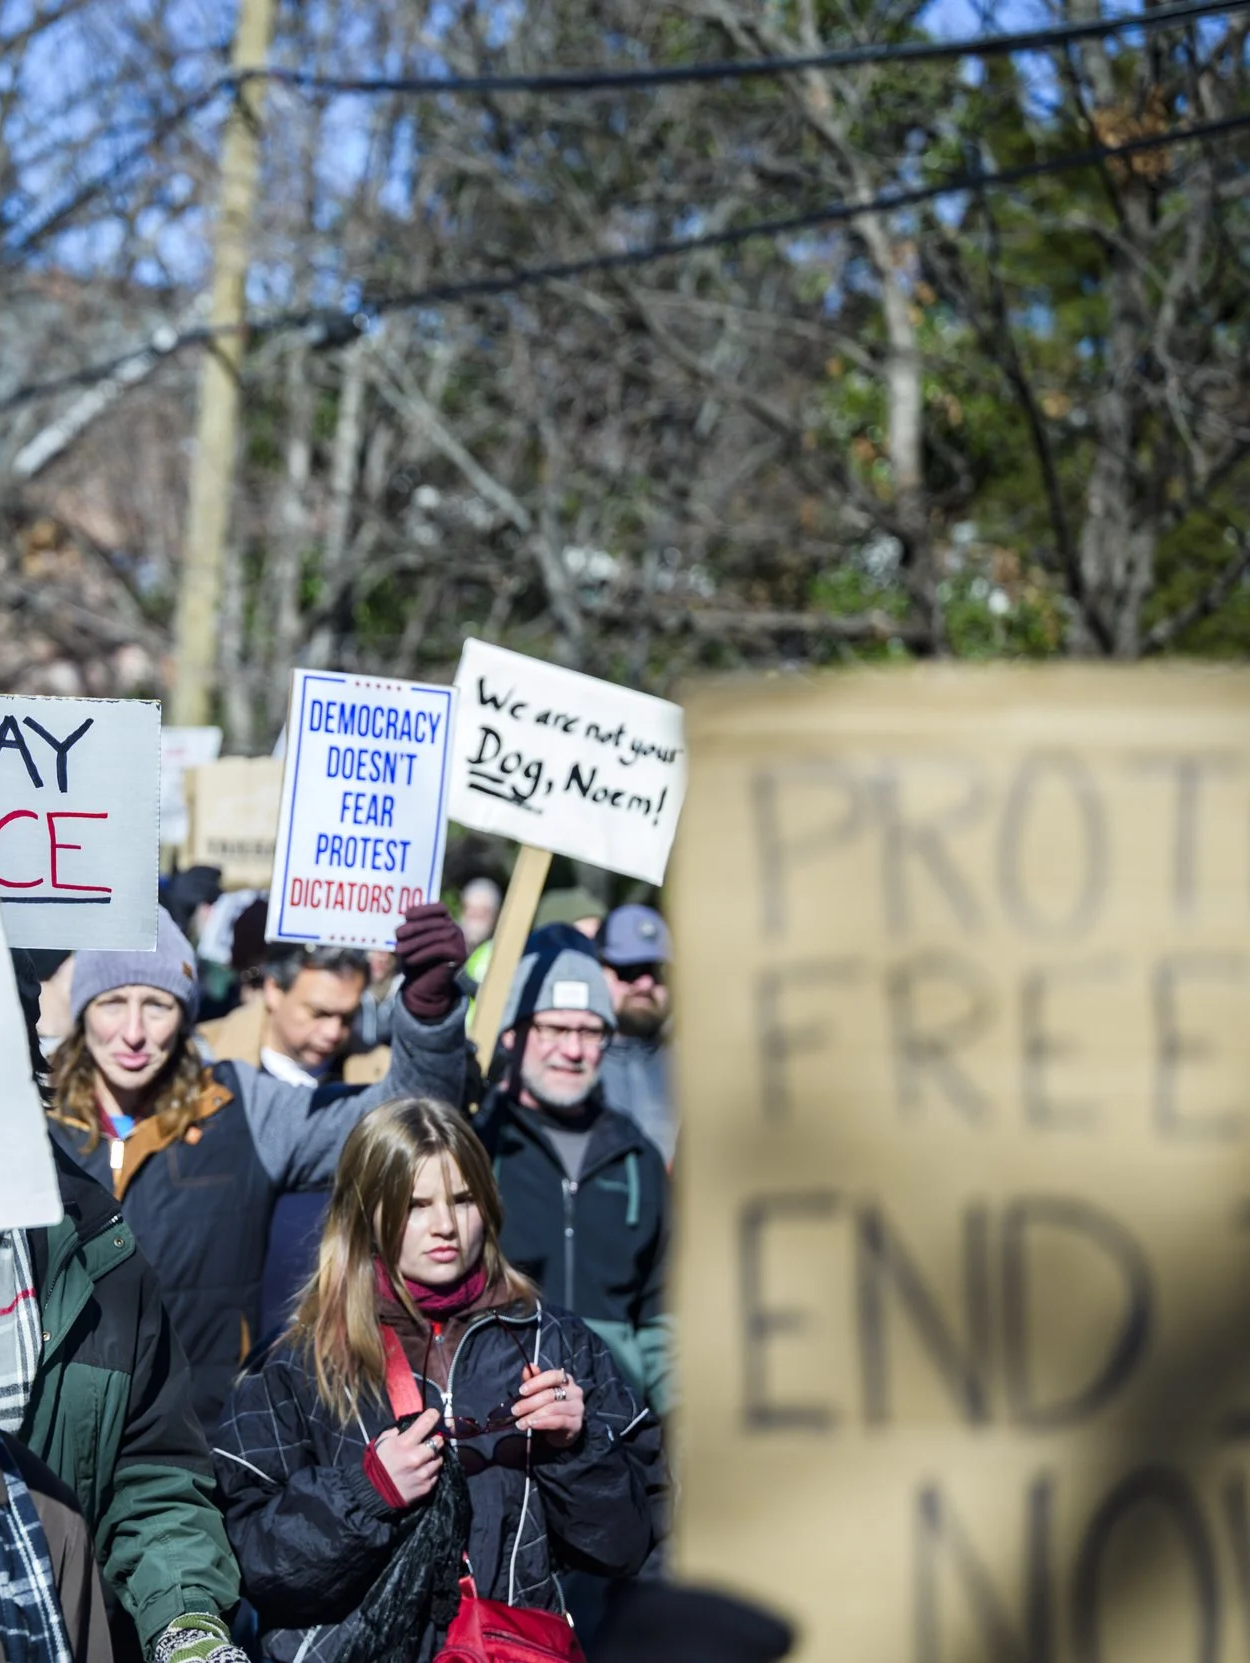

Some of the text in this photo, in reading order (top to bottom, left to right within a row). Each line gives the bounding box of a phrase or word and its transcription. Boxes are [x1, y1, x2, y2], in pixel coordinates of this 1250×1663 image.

[308, 700, 441, 745] DEMOCRACY
[477, 676, 684, 767] We are not your
[326, 746, 418, 786] DOESN'T
[467, 726, 668, 827] Dog, Noem!
[339, 791, 395, 828] FEAR
[314, 833, 412, 874] PROTEST
[289, 877, 423, 916] DICTATORS DO
[740, 1190, 1158, 1438] END
[915, 1463, 1250, 1663] NO
